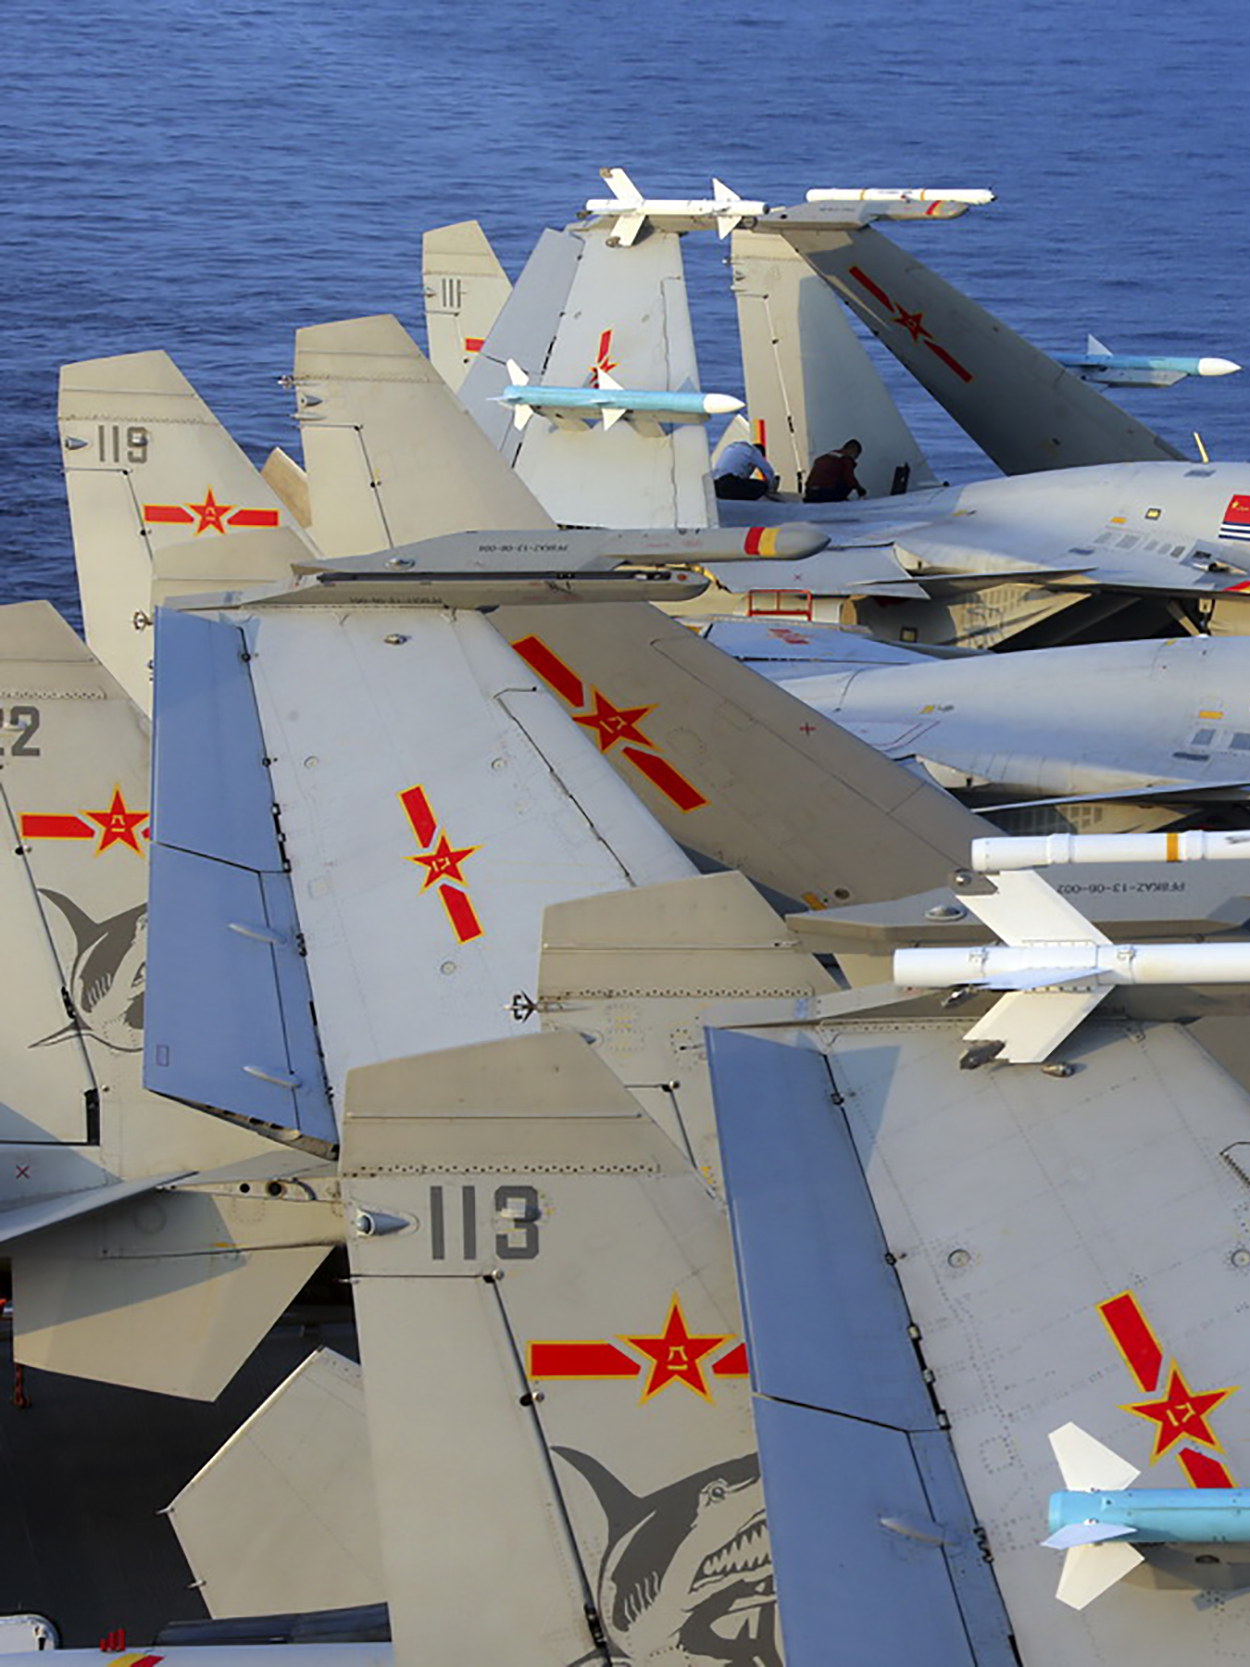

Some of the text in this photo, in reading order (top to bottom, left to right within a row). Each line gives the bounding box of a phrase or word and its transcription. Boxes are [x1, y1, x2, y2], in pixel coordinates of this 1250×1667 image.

[441, 278, 461, 308] 111
[98, 425, 148, 464] 119
[0, 706, 40, 757] 2
[430, 1185, 540, 1260] 113
